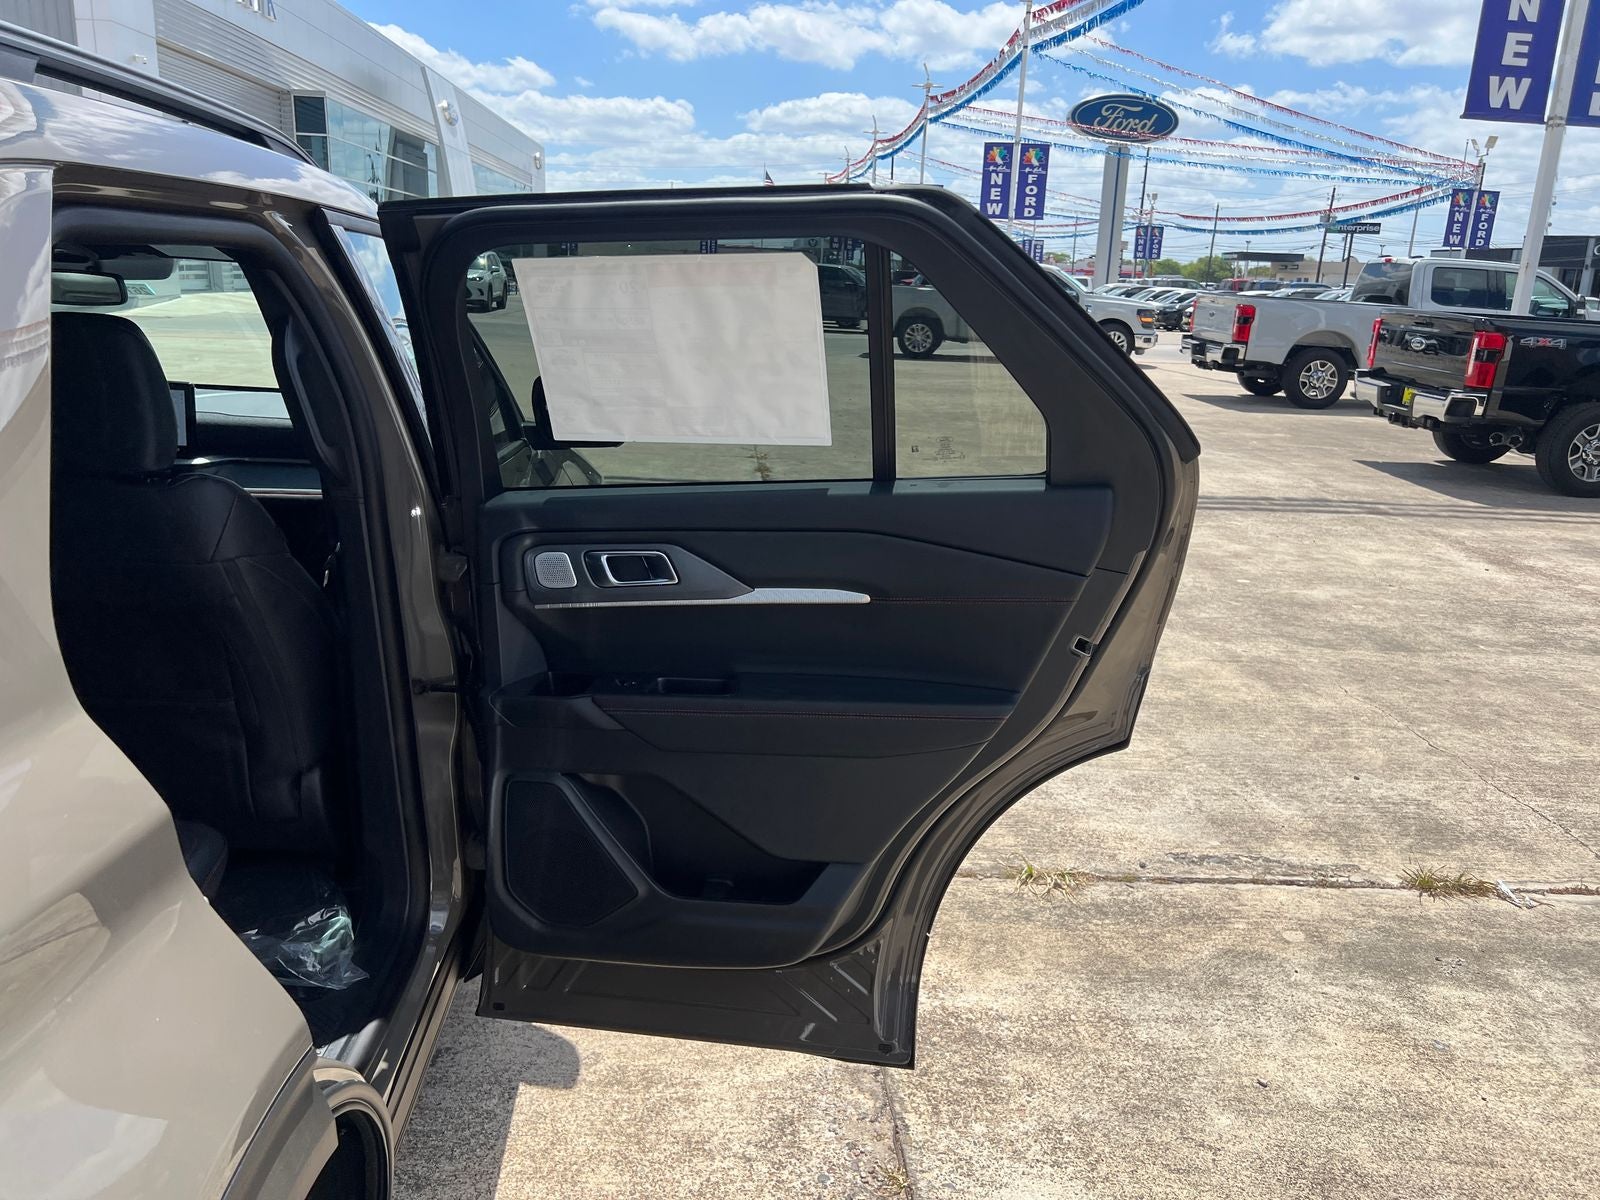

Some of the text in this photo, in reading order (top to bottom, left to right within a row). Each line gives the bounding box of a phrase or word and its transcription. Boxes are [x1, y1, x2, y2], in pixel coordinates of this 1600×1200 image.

[1488, 0, 1541, 110] NEW
[1093, 103, 1158, 134] Ford
[987, 172, 1002, 215] NEW
[1023, 174, 1038, 217] FORD
[1449, 212, 1464, 245] NEW
[1475, 213, 1489, 246] FORD
[1136, 239, 1144, 258] NEW
[1151, 239, 1159, 259] FORD
